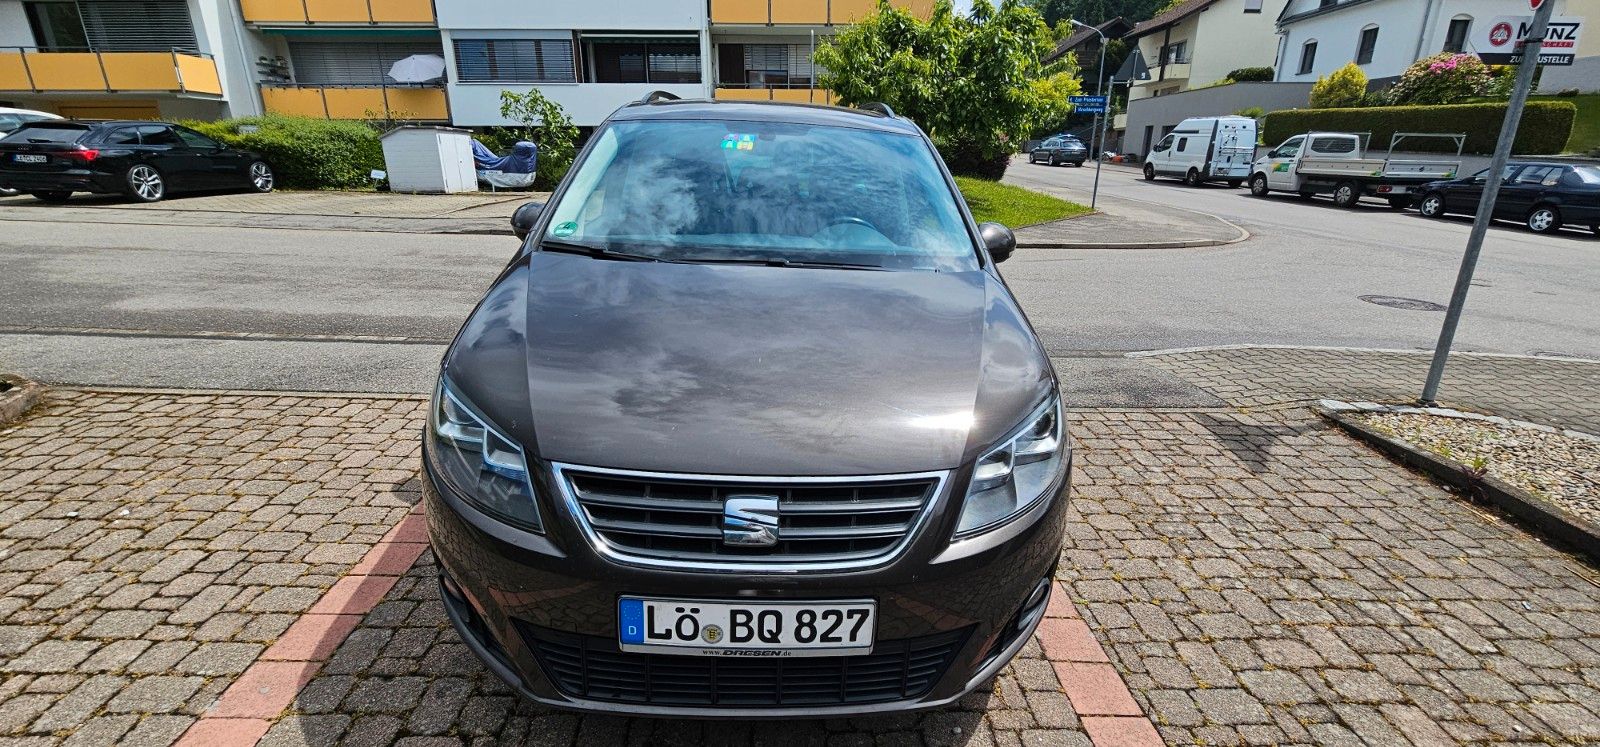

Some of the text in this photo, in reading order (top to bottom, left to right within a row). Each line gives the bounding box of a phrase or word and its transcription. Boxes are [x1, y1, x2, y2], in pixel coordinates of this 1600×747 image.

[628, 605, 870, 643] D LÖ BQ 827
